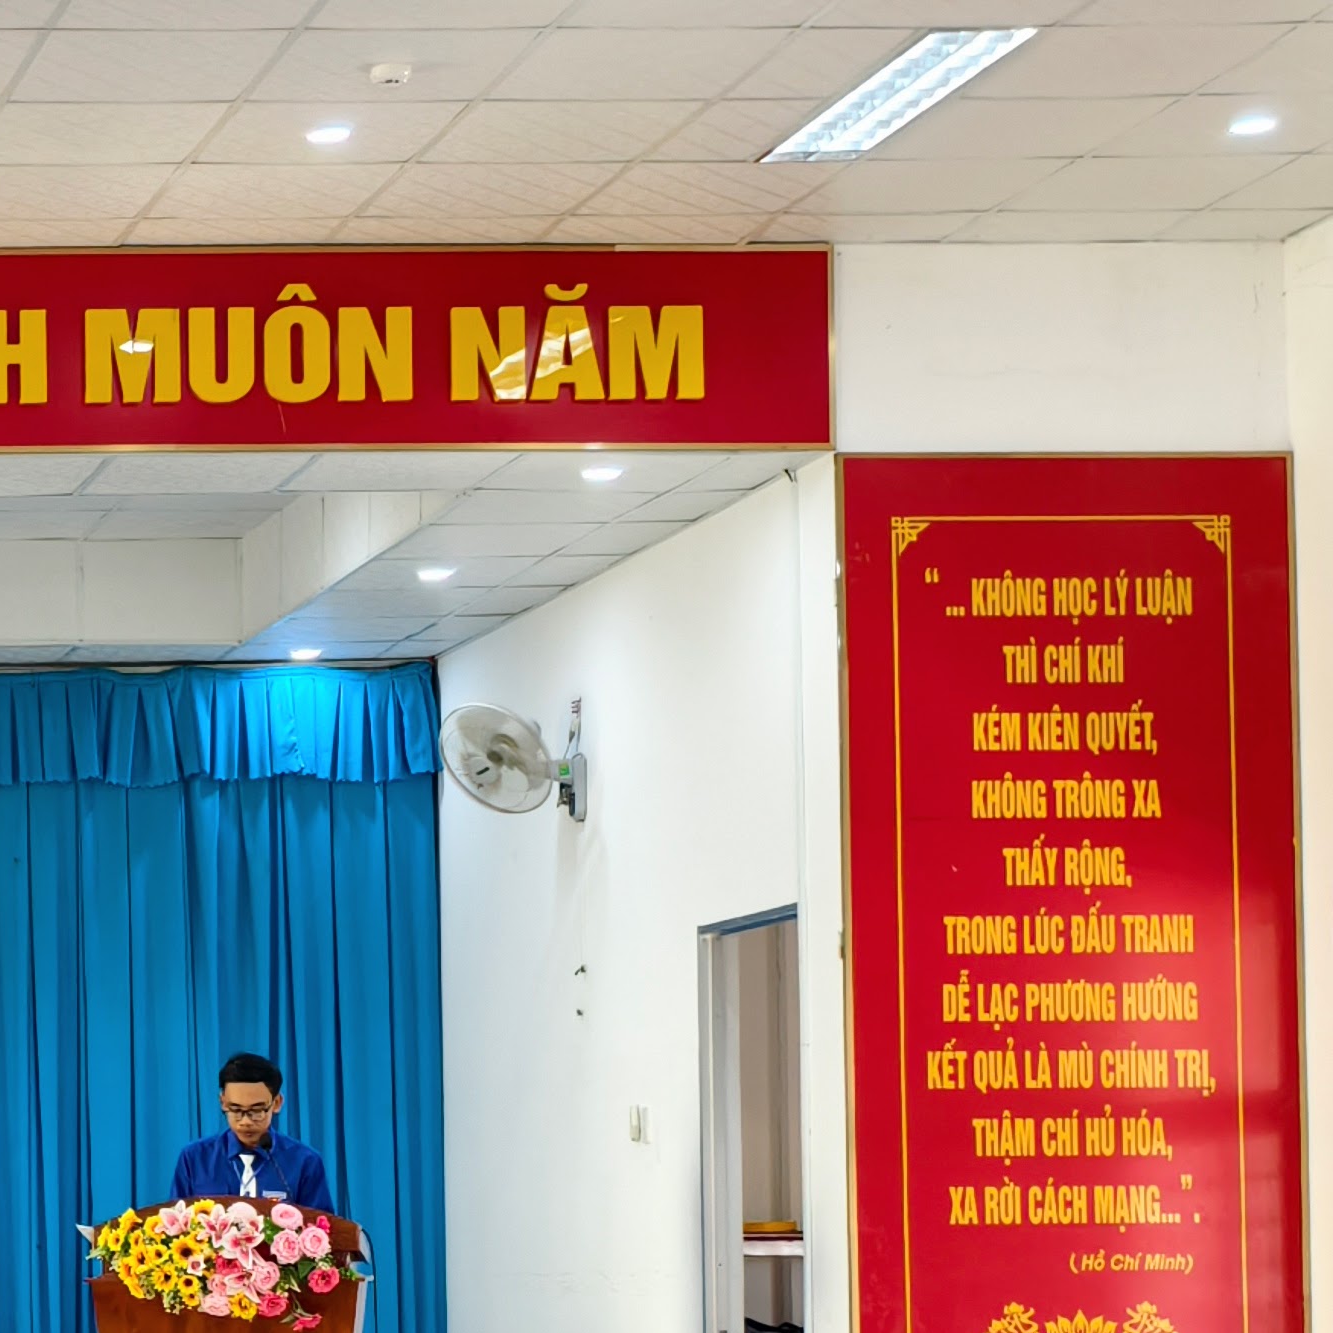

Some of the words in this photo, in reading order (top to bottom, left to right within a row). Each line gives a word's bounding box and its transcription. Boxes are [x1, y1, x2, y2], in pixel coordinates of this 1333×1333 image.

[85, 284, 414, 404] MUÔN
[450, 283, 705, 401] NĂM
[972, 570, 1046, 617] KHÔNG
[1053, 578, 1097, 624] HỌC
[1104, 570, 1128, 615] LÝ
[1136, 569, 1192, 624] LUẬN
[1003, 637, 1037, 683] THÌ
[1044, 637, 1080, 683] CHÍ
[1088, 637, 1123, 683] KHÍ
[973, 705, 1021, 751] KÉM
[1028, 705, 1079, 750] KIÊN
[1086, 700, 1157, 754] QUYẾT,
[972, 772, 1047, 818] KHÔNG
[1053, 772, 1125, 818] TRÔNG
[1133, 780, 1161, 818] XA
[1002, 834, 1058, 886] THẤY
[1065, 840, 1132, 895] RỘNG,
[943, 916, 1017, 954] TRONG
[1023, 908, 1064, 954] LÚC
[1071, 902, 1116, 954] ĐẤU
[1121, 915, 1195, 954] TRANH
[942, 970, 971, 1022] DỄ
[977, 983, 1018, 1030] LẠC
[1025, 980, 1117, 1022] PHƯƠNG
[1122, 975, 1199, 1022] HƯỚNG
[927, 1039, 967, 1089] KẾT
[974, 1038, 1019, 1094] QUẢ
[1025, 1043, 1052, 1088] LÀ
[1058, 1043, 1093, 1088] MÙ
[1100, 1043, 1169, 1089] CHÍNH
[1174, 1050, 1216, 1097] TRỊ,
[972, 1111, 1035, 1166] THẬM
[1042, 1110, 1079, 1157] CHÍ
[1085, 1105, 1115, 1157] HỦ
[1122, 1110, 1173, 1160] HÓA,
[949, 1187, 979, 1225] XA
[984, 1177, 1021, 1225] RỜI
[1028, 1178, 1088, 1225] CÁCH
